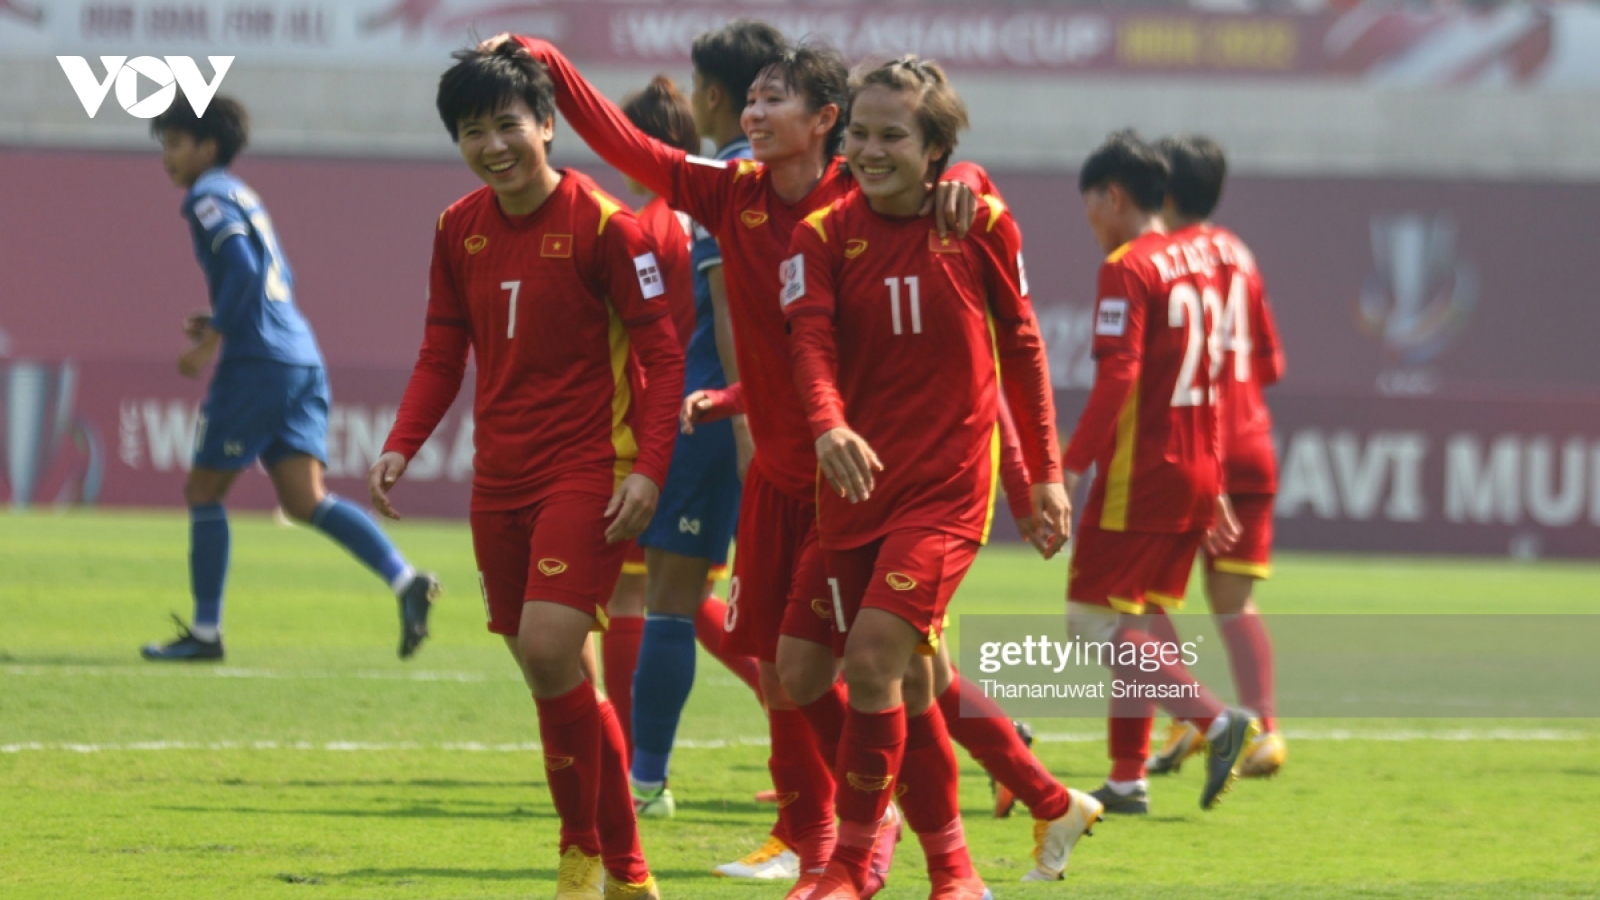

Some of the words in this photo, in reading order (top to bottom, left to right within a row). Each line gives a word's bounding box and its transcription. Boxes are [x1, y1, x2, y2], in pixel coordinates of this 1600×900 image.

[501, 280, 521, 339] 7
[884, 276, 922, 335] 11
[1275, 433, 1424, 522] AVI
[1446, 437, 1600, 526] MU
